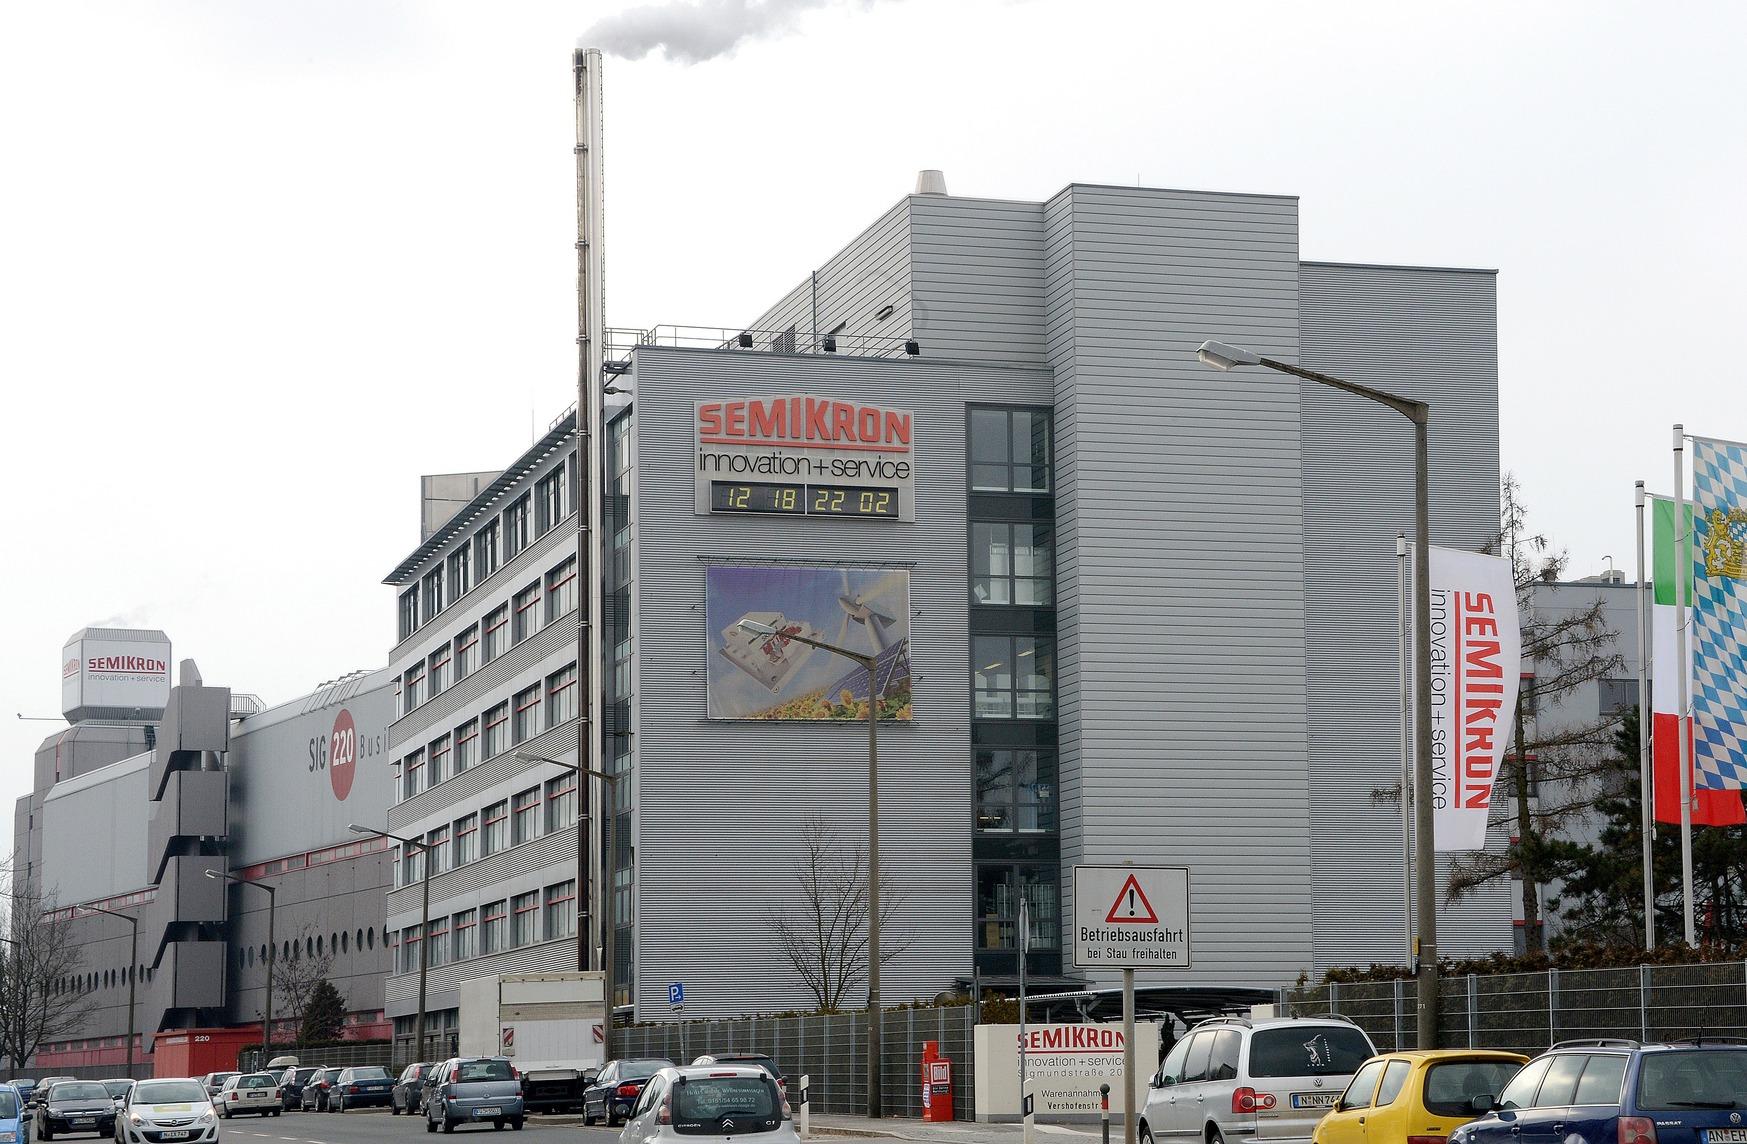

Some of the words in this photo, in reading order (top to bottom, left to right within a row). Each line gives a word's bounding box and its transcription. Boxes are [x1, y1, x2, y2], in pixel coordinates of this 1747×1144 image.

[700, 397, 910, 444] SEMIKRON
[728, 487, 750, 509] 12
[774, 489, 796, 510] 18
[815, 490, 845, 512] 22
[859, 492, 890, 513] 02
[1430, 589, 1451, 706] innovation
[88, 655, 166, 671] SEMIKRON
[87, 673, 129, 682] innovation
[136, 675, 166, 683] service
[309, 735, 327, 773] SIG
[332, 727, 354, 767] 220
[1431, 729, 1451, 810] service
[1080, 926, 1184, 943] Betriebsausfahrt
[1087, 947, 1101, 959] bei
[1106, 947, 1127, 959] Stau
[1132, 947, 1177, 960] freihalten
[1041, 1089, 1102, 1098] Warenannahm
[1708, 1130, 1724, 1142] AN
